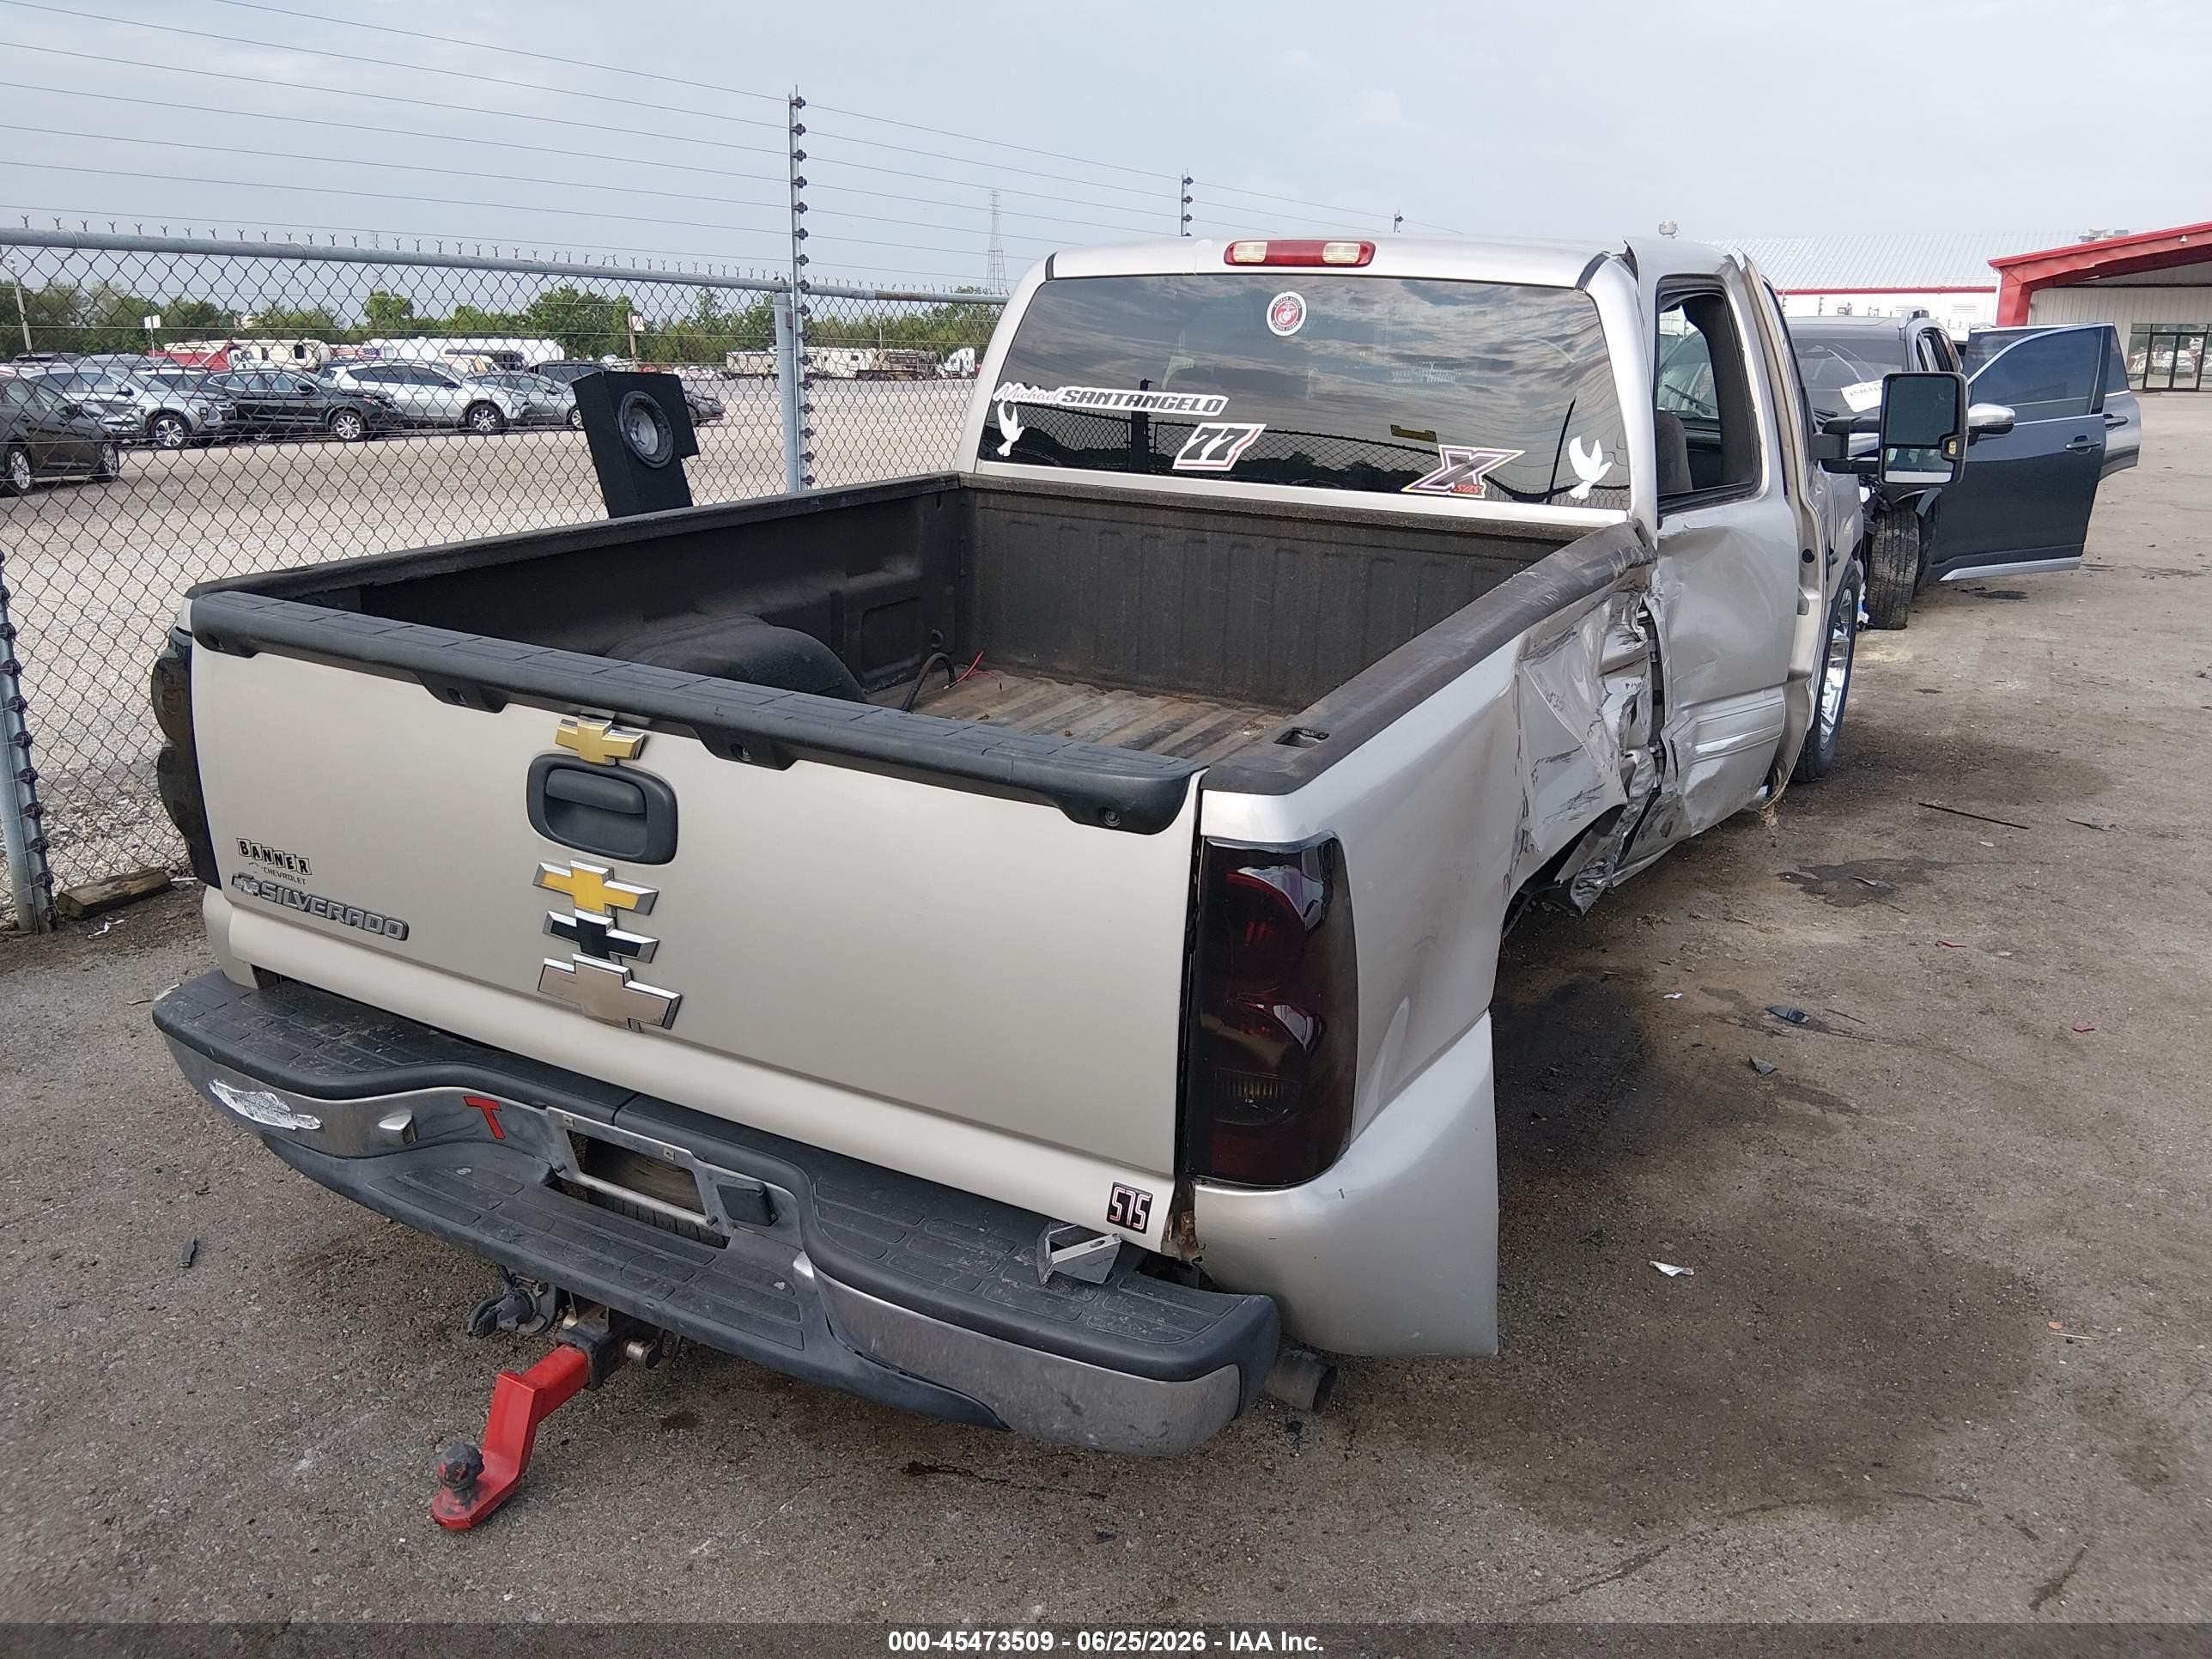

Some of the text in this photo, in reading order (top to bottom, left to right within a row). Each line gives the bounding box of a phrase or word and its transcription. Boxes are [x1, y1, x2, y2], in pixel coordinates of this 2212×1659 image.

[996, 384, 1224, 413] Michael SANTANGELO
[1180, 427, 1252, 461] 77
[236, 838, 312, 875] BANNER
[263, 866, 307, 885] CHEVROLET
[260, 880, 409, 941] SILVERADO
[463, 1096, 505, 1140] T
[1109, 1186, 1152, 1230] 575
